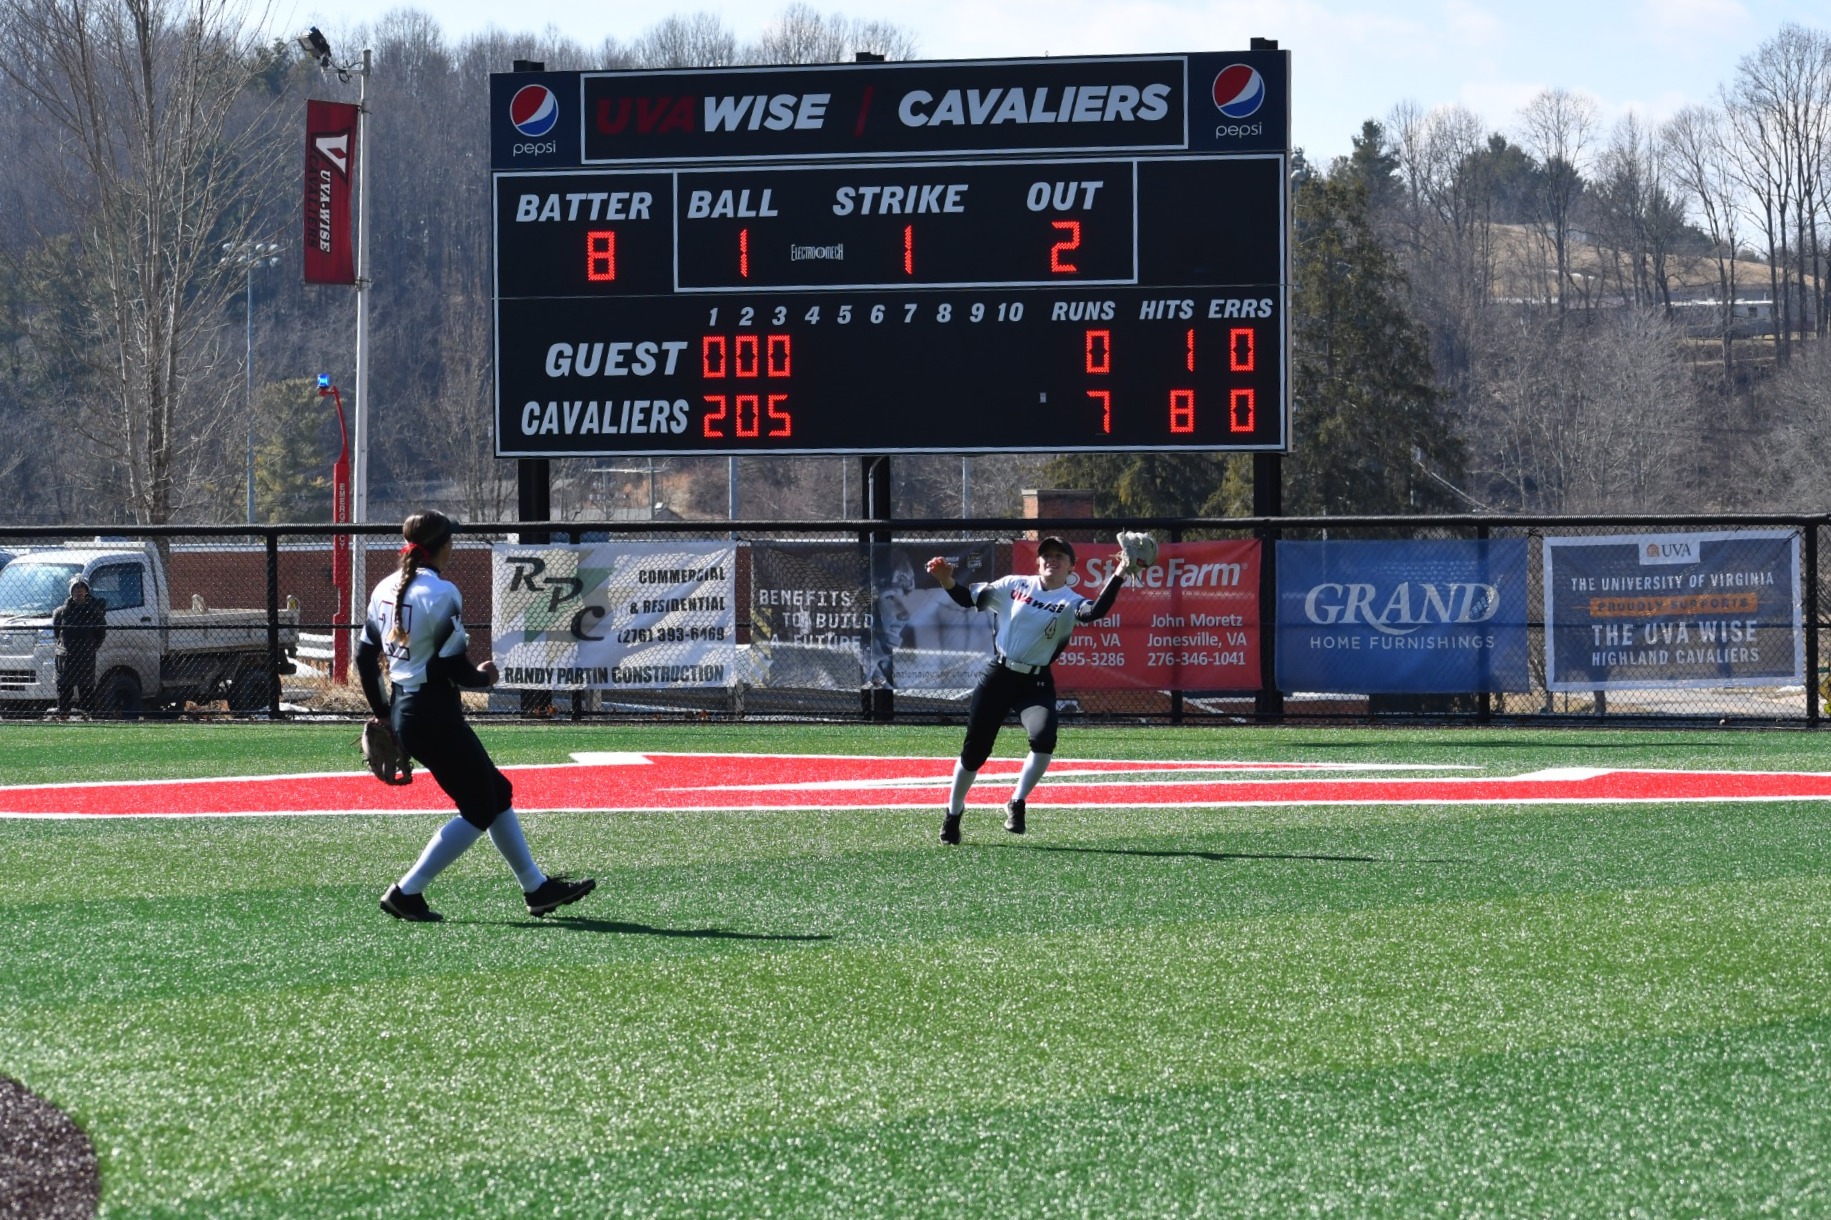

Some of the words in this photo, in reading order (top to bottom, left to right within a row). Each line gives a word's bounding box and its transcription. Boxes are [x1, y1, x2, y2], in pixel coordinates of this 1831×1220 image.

[898, 83, 1171, 127] CAVALIERS
[1215, 122, 1262, 139] pepsi
[513, 140, 556, 157] pepsi
[515, 191, 653, 222] BATTER
[687, 189, 778, 219] BALL
[833, 184, 968, 216] STRIKE
[1027, 181, 1103, 211] OUT
[587, 231, 615, 281] 8
[739, 228, 748, 278] 1
[904, 225, 912, 274] 1
[1051, 221, 1080, 272] 2
[709, 307, 718, 326] 1
[739, 307, 754, 326] 2
[772, 306, 787, 325] 3
[805, 306, 820, 324] 4
[837, 305, 852, 324] 5
[870, 305, 885, 323] 6
[904, 304, 917, 323] 7
[936, 303, 952, 323] 8
[970, 303, 985, 322] 9
[997, 302, 1024, 322] 10
[1051, 301, 1116, 321] RUNS
[1139, 300, 1195, 320] HITS
[1208, 299, 1273, 319] ERRS
[545, 341, 688, 377] GUEST
[1086, 330, 1110, 373] 0
[1187, 329, 1194, 372] 1
[1230, 328, 1254, 371] 0
[521, 399, 689, 436] CAVALIERS
[1086, 390, 1110, 433] 7
[1170, 389, 1194, 433] 8
[1230, 389, 1254, 432] 0
[1662, 543, 1691, 558] UVA
[639, 568, 725, 585] COMMERCIAL
[1571, 577, 1596, 591] THE
[1601, 575, 1683, 590] UNIVERSITY
[1689, 574, 1705, 588] OF
[1710, 572, 1774, 587] VIRGINIA
[630, 603, 638, 614] &
[643, 597, 725, 613] RESIDENTIAL
[760, 589, 851, 606] BENEFITS
[1597, 601, 1663, 612] PROUDLY
[1670, 598, 1748, 610] SUPPORTS
[1305, 582, 1499, 635] GRAND
[783, 613, 801, 628] TO
[816, 613, 873, 628] BUILD
[1045, 617, 1057, 639] 4
[1151, 613, 1185, 628] John
[1190, 613, 1242, 627] Moretz
[617, 629, 653, 643] (276)
[1069, 635, 1097, 649] urn,
[1100, 633, 1121, 647] VA
[1147, 632, 1222, 648] Jonesville,
[1227, 632, 1247, 646] VA
[1311, 636, 1361, 649] HOME
[1370, 635, 1495, 649] FURNISHINGS
[1592, 624, 1634, 646] THE
[1644, 621, 1690, 645] UVA
[1699, 620, 1758, 643] WISE
[1148, 652, 1245, 666] 276-346-1041
[1592, 650, 1668, 666] HIGHLAND
[1676, 647, 1759, 665] CAVALIERS
[505, 667, 554, 685] RANDY
[557, 666, 608, 685] PARTIN
[612, 664, 724, 684] CONSTRUCTION
